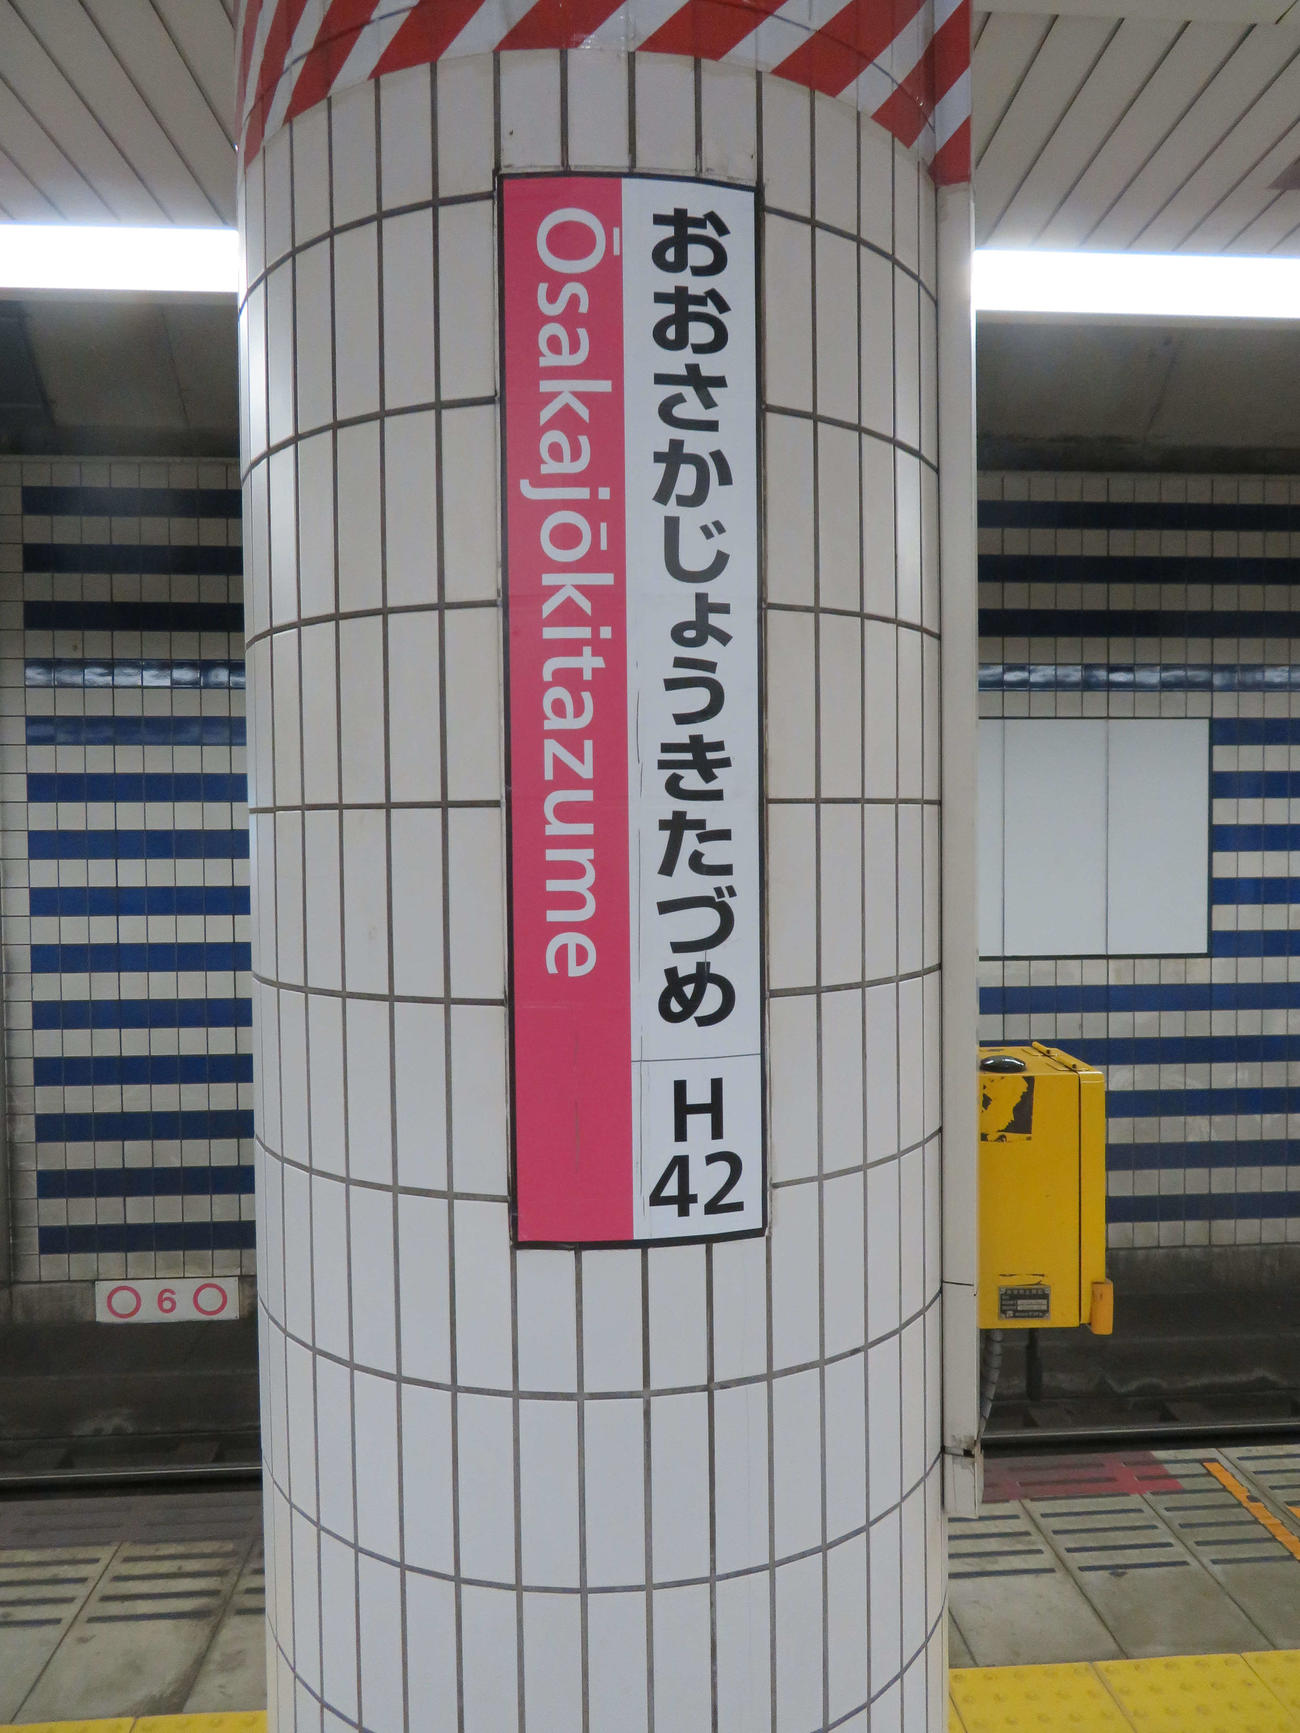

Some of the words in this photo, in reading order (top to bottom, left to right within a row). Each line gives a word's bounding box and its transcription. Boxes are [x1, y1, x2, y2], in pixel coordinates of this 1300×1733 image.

[520, 207, 620, 977] Ōsakajōkitazume
[651, 207, 737, 1027] おおさかじょうきたづめ
[648, 1150, 745, 1218] 42
[672, 1077, 724, 1143] H
